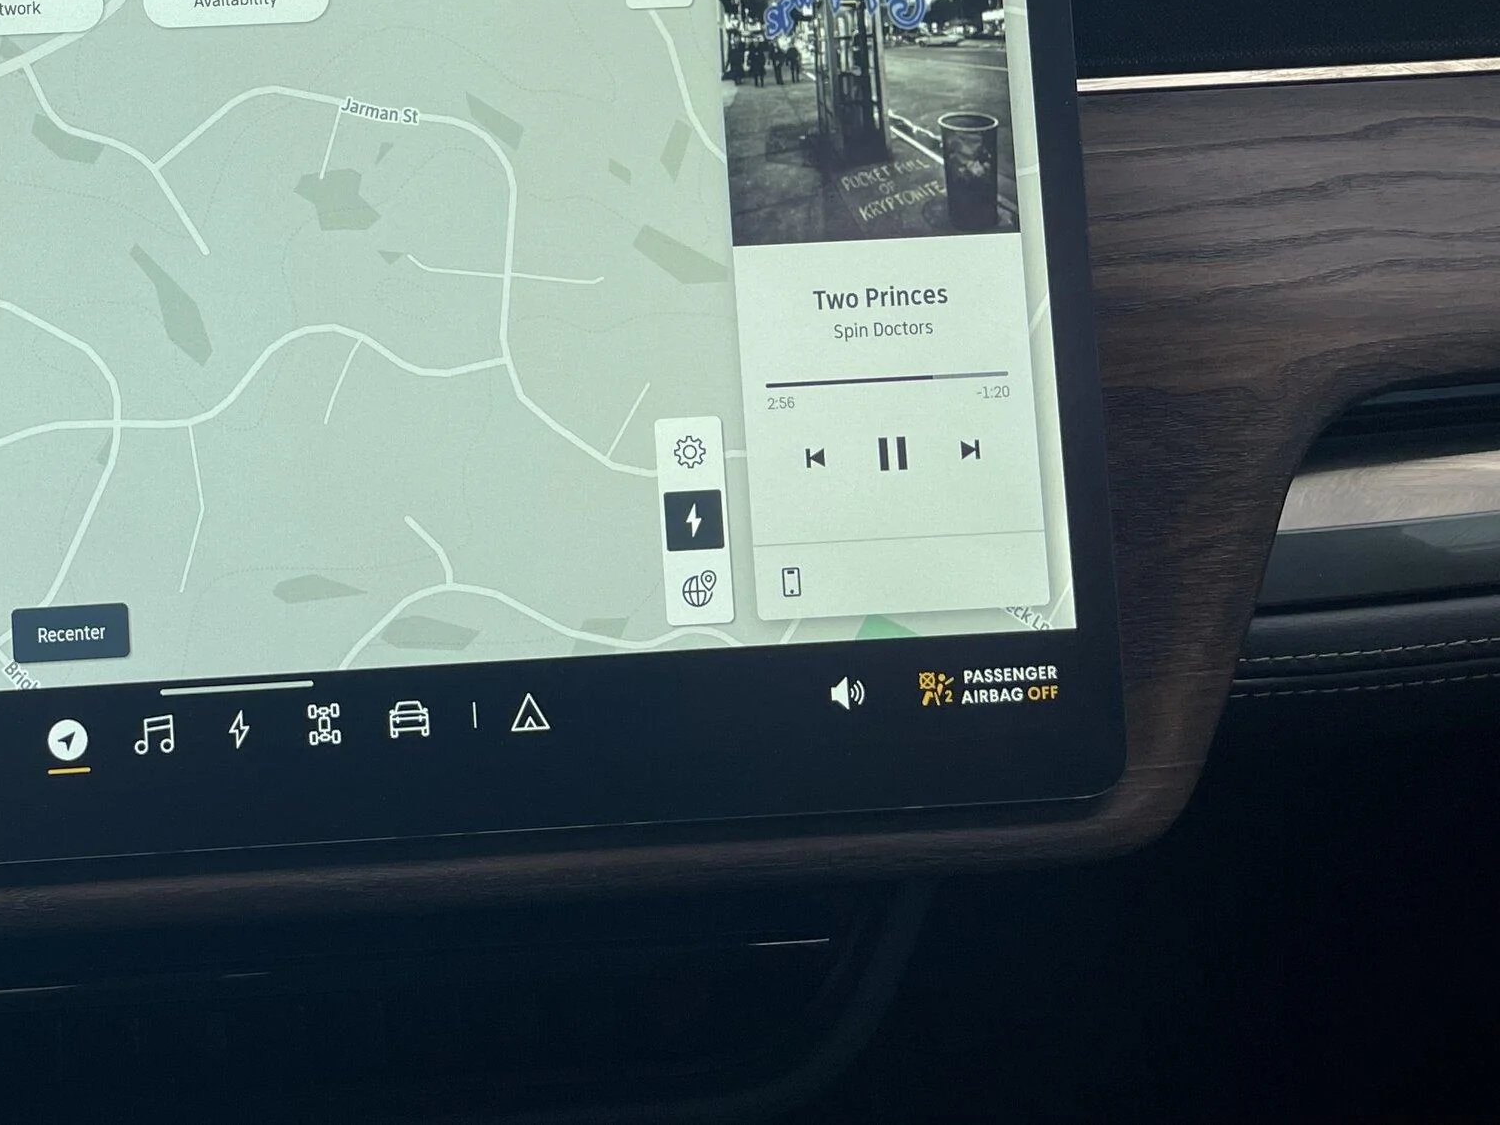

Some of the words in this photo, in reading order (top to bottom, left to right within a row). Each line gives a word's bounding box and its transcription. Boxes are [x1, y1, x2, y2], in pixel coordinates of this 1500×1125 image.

[341, 98, 399, 122] Jarman
[401, 107, 419, 124] St
[813, 290, 858, 310] Two
[866, 286, 948, 308] Princes
[834, 323, 868, 342] Spin
[873, 321, 933, 337] Doctors
[976, 385, 1010, 400] -1:20
[767, 396, 795, 410] 2:56
[38, 625, 106, 644] Recenter
[963, 666, 1058, 684] PASSENGER
[961, 687, 1023, 704] AIRBAG
[1027, 686, 1058, 701] OFF
